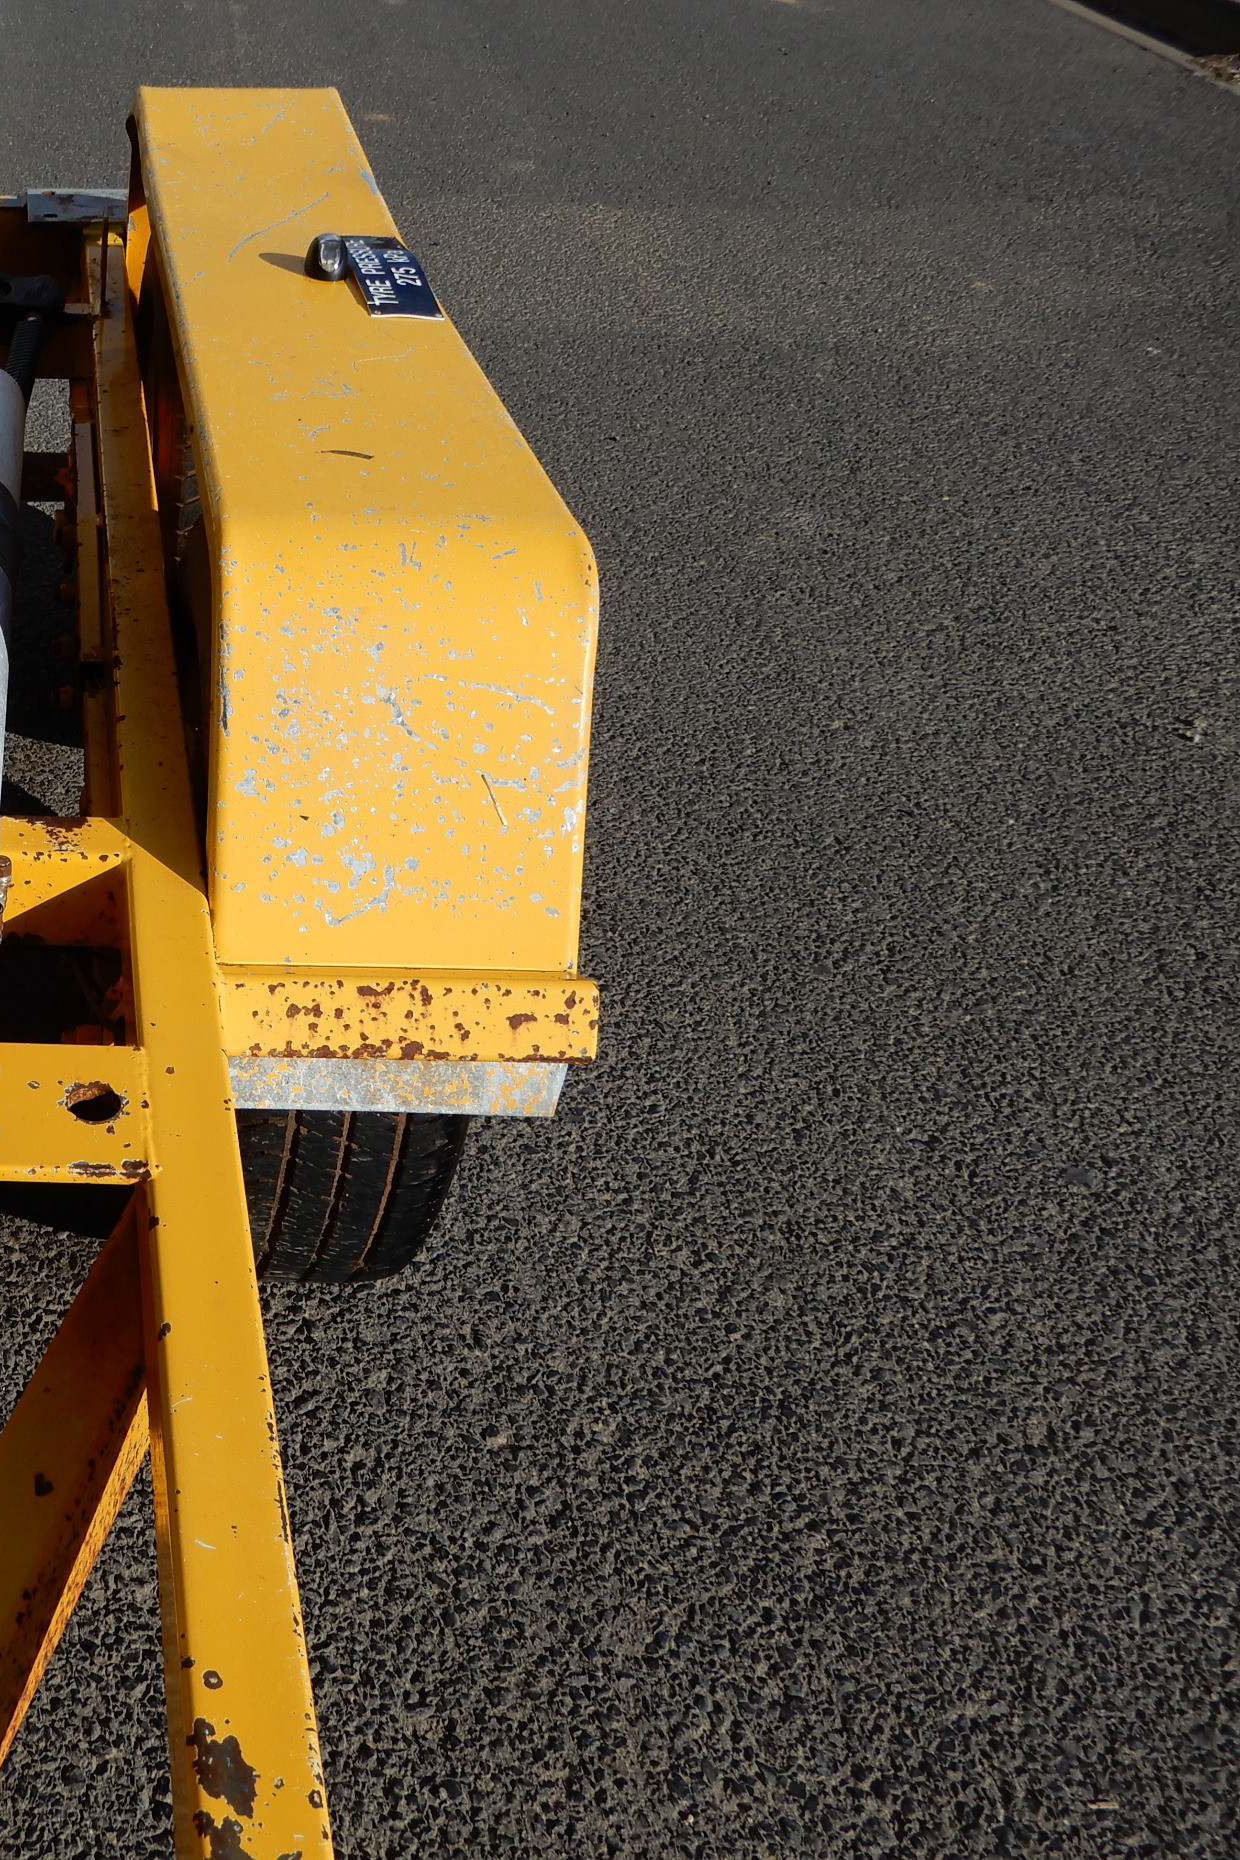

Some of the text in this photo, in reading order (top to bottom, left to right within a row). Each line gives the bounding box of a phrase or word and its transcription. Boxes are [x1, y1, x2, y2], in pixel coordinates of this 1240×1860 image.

[382, 250, 422, 287] 275 kPa
[365, 279, 399, 306] TYRE
